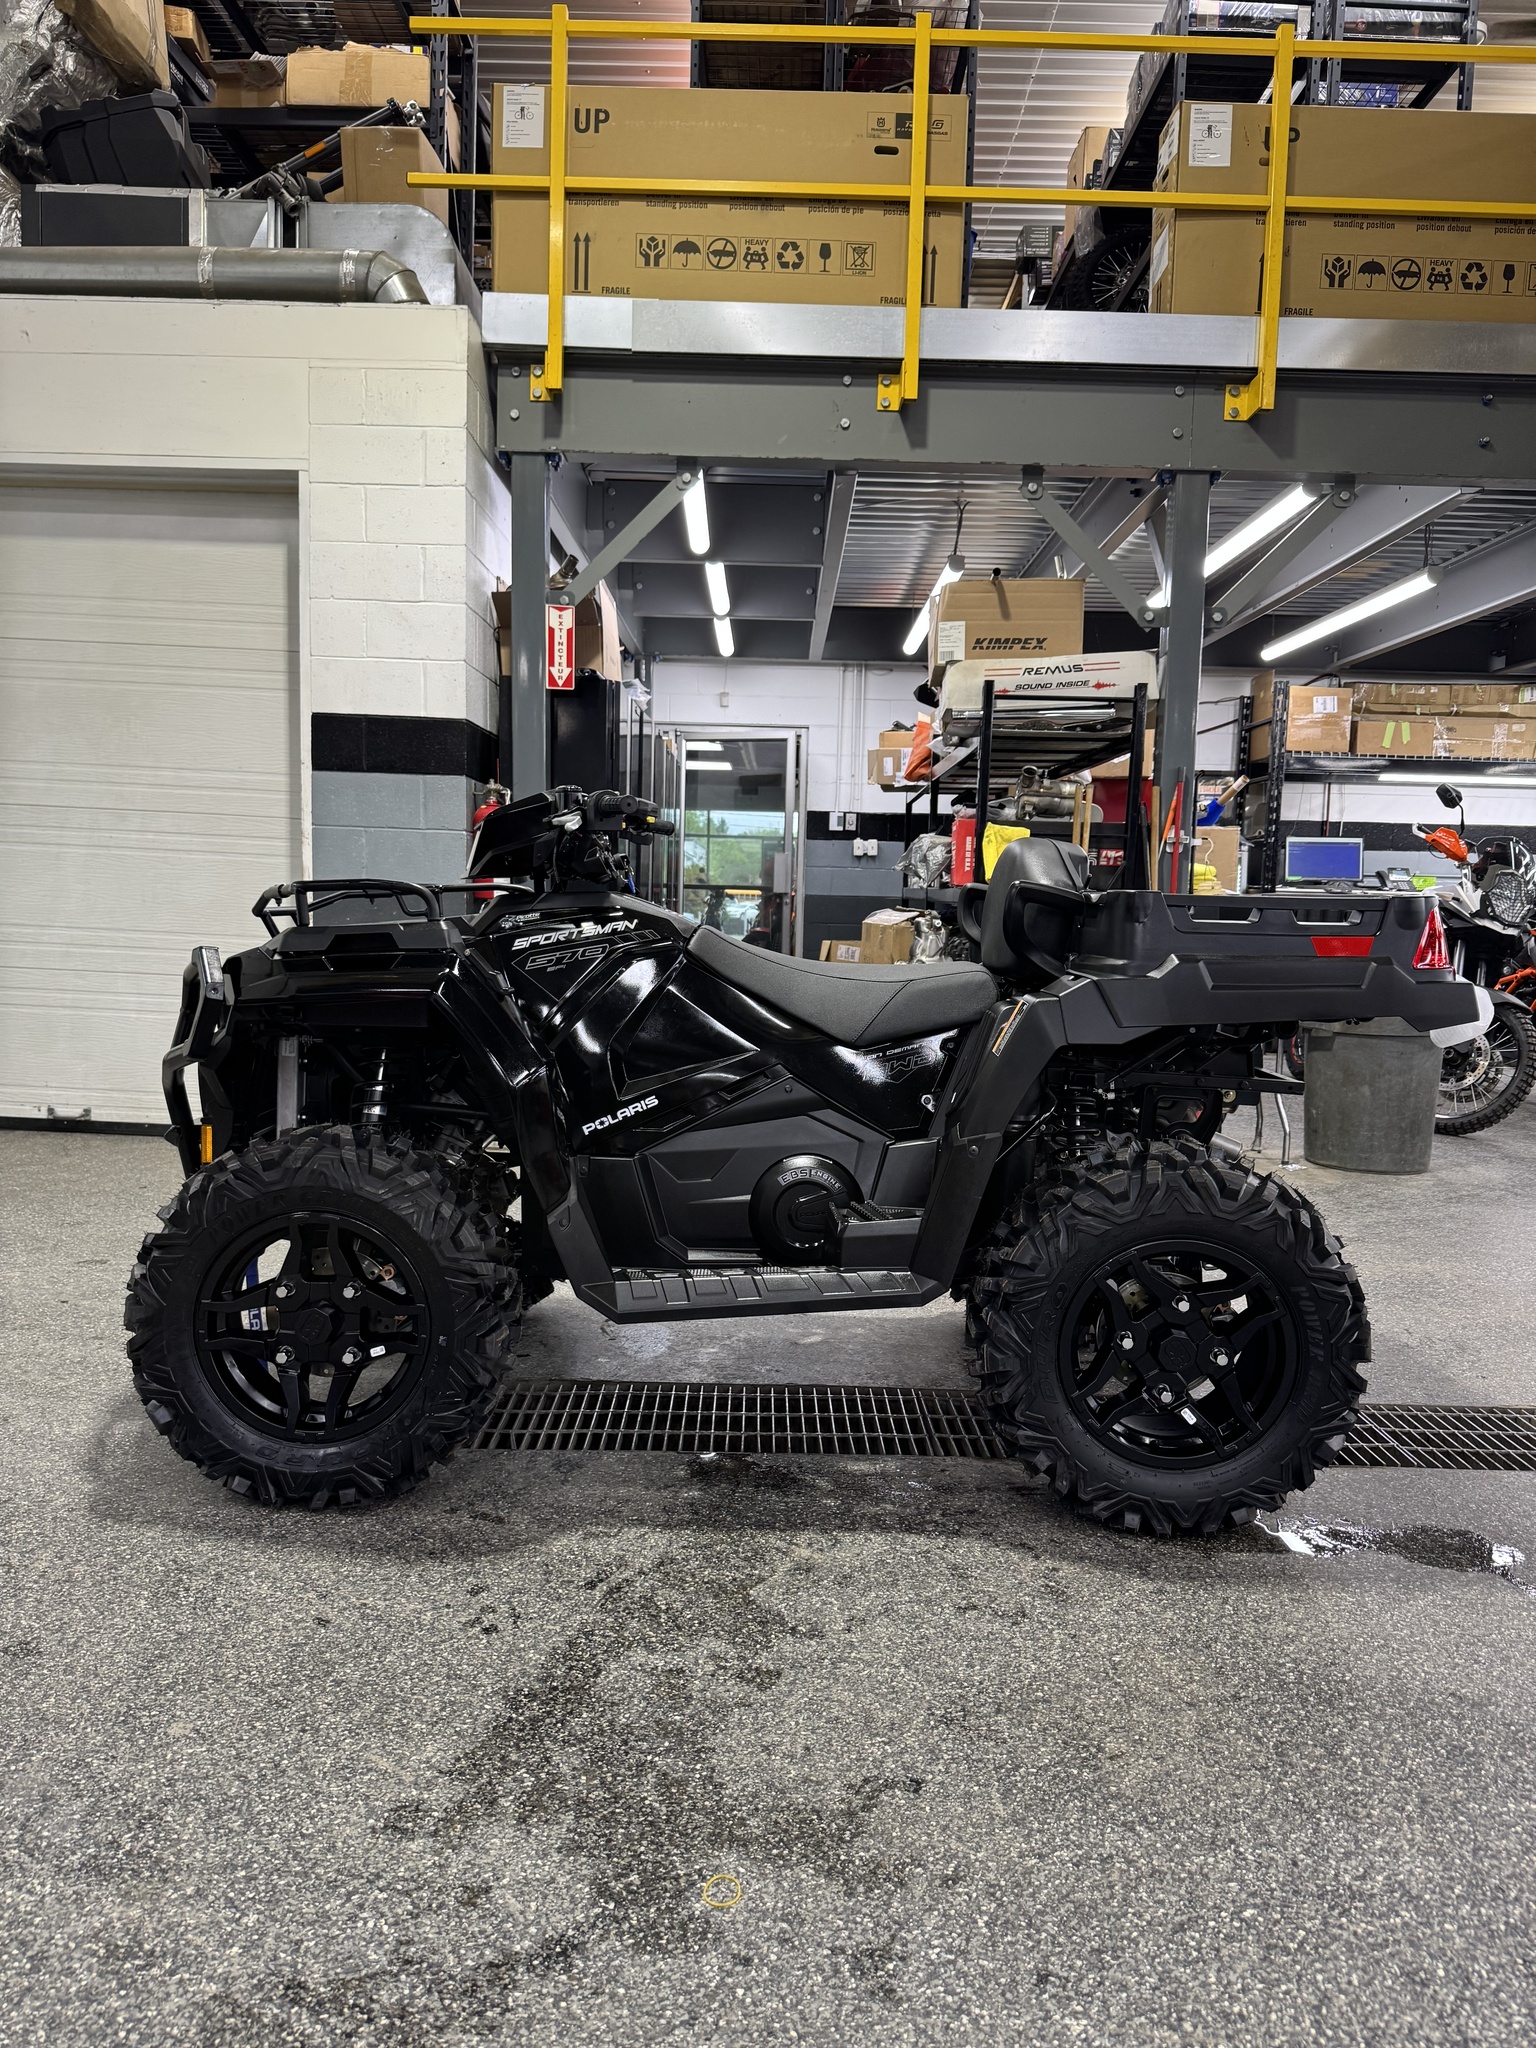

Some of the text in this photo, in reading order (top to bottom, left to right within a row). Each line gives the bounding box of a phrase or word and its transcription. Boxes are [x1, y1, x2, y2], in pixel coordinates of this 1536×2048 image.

[575, 108, 610, 134] UP
[568, 198, 620, 207] transportieren
[645, 200, 708, 210] standing position
[729, 202, 785, 212] position debout
[841, 206, 850, 214] de
[852, 207, 864, 216] pie
[1333, 220, 1395, 231] standing position
[1416, 222, 1472, 233] position debout
[1494, 225, 1525, 235] posición
[744, 238, 770, 247] HEAVY
[1429, 259, 1454, 268] HEAVY
[601, 286, 631, 295] FRAGILE
[1284, 307, 1314, 316] FRAGILE
[972, 637, 1048, 651] KIMPEX
[1021, 663, 1085, 677] REMUS
[1014, 680, 1091, 691] SOUND INSIDE
[512, 919, 639, 951] SPORTSMAN
[525, 944, 609, 970] 570
[582, 1095, 659, 1136] POLARIS
[780, 1168, 842, 1190] EBS ENGINE
